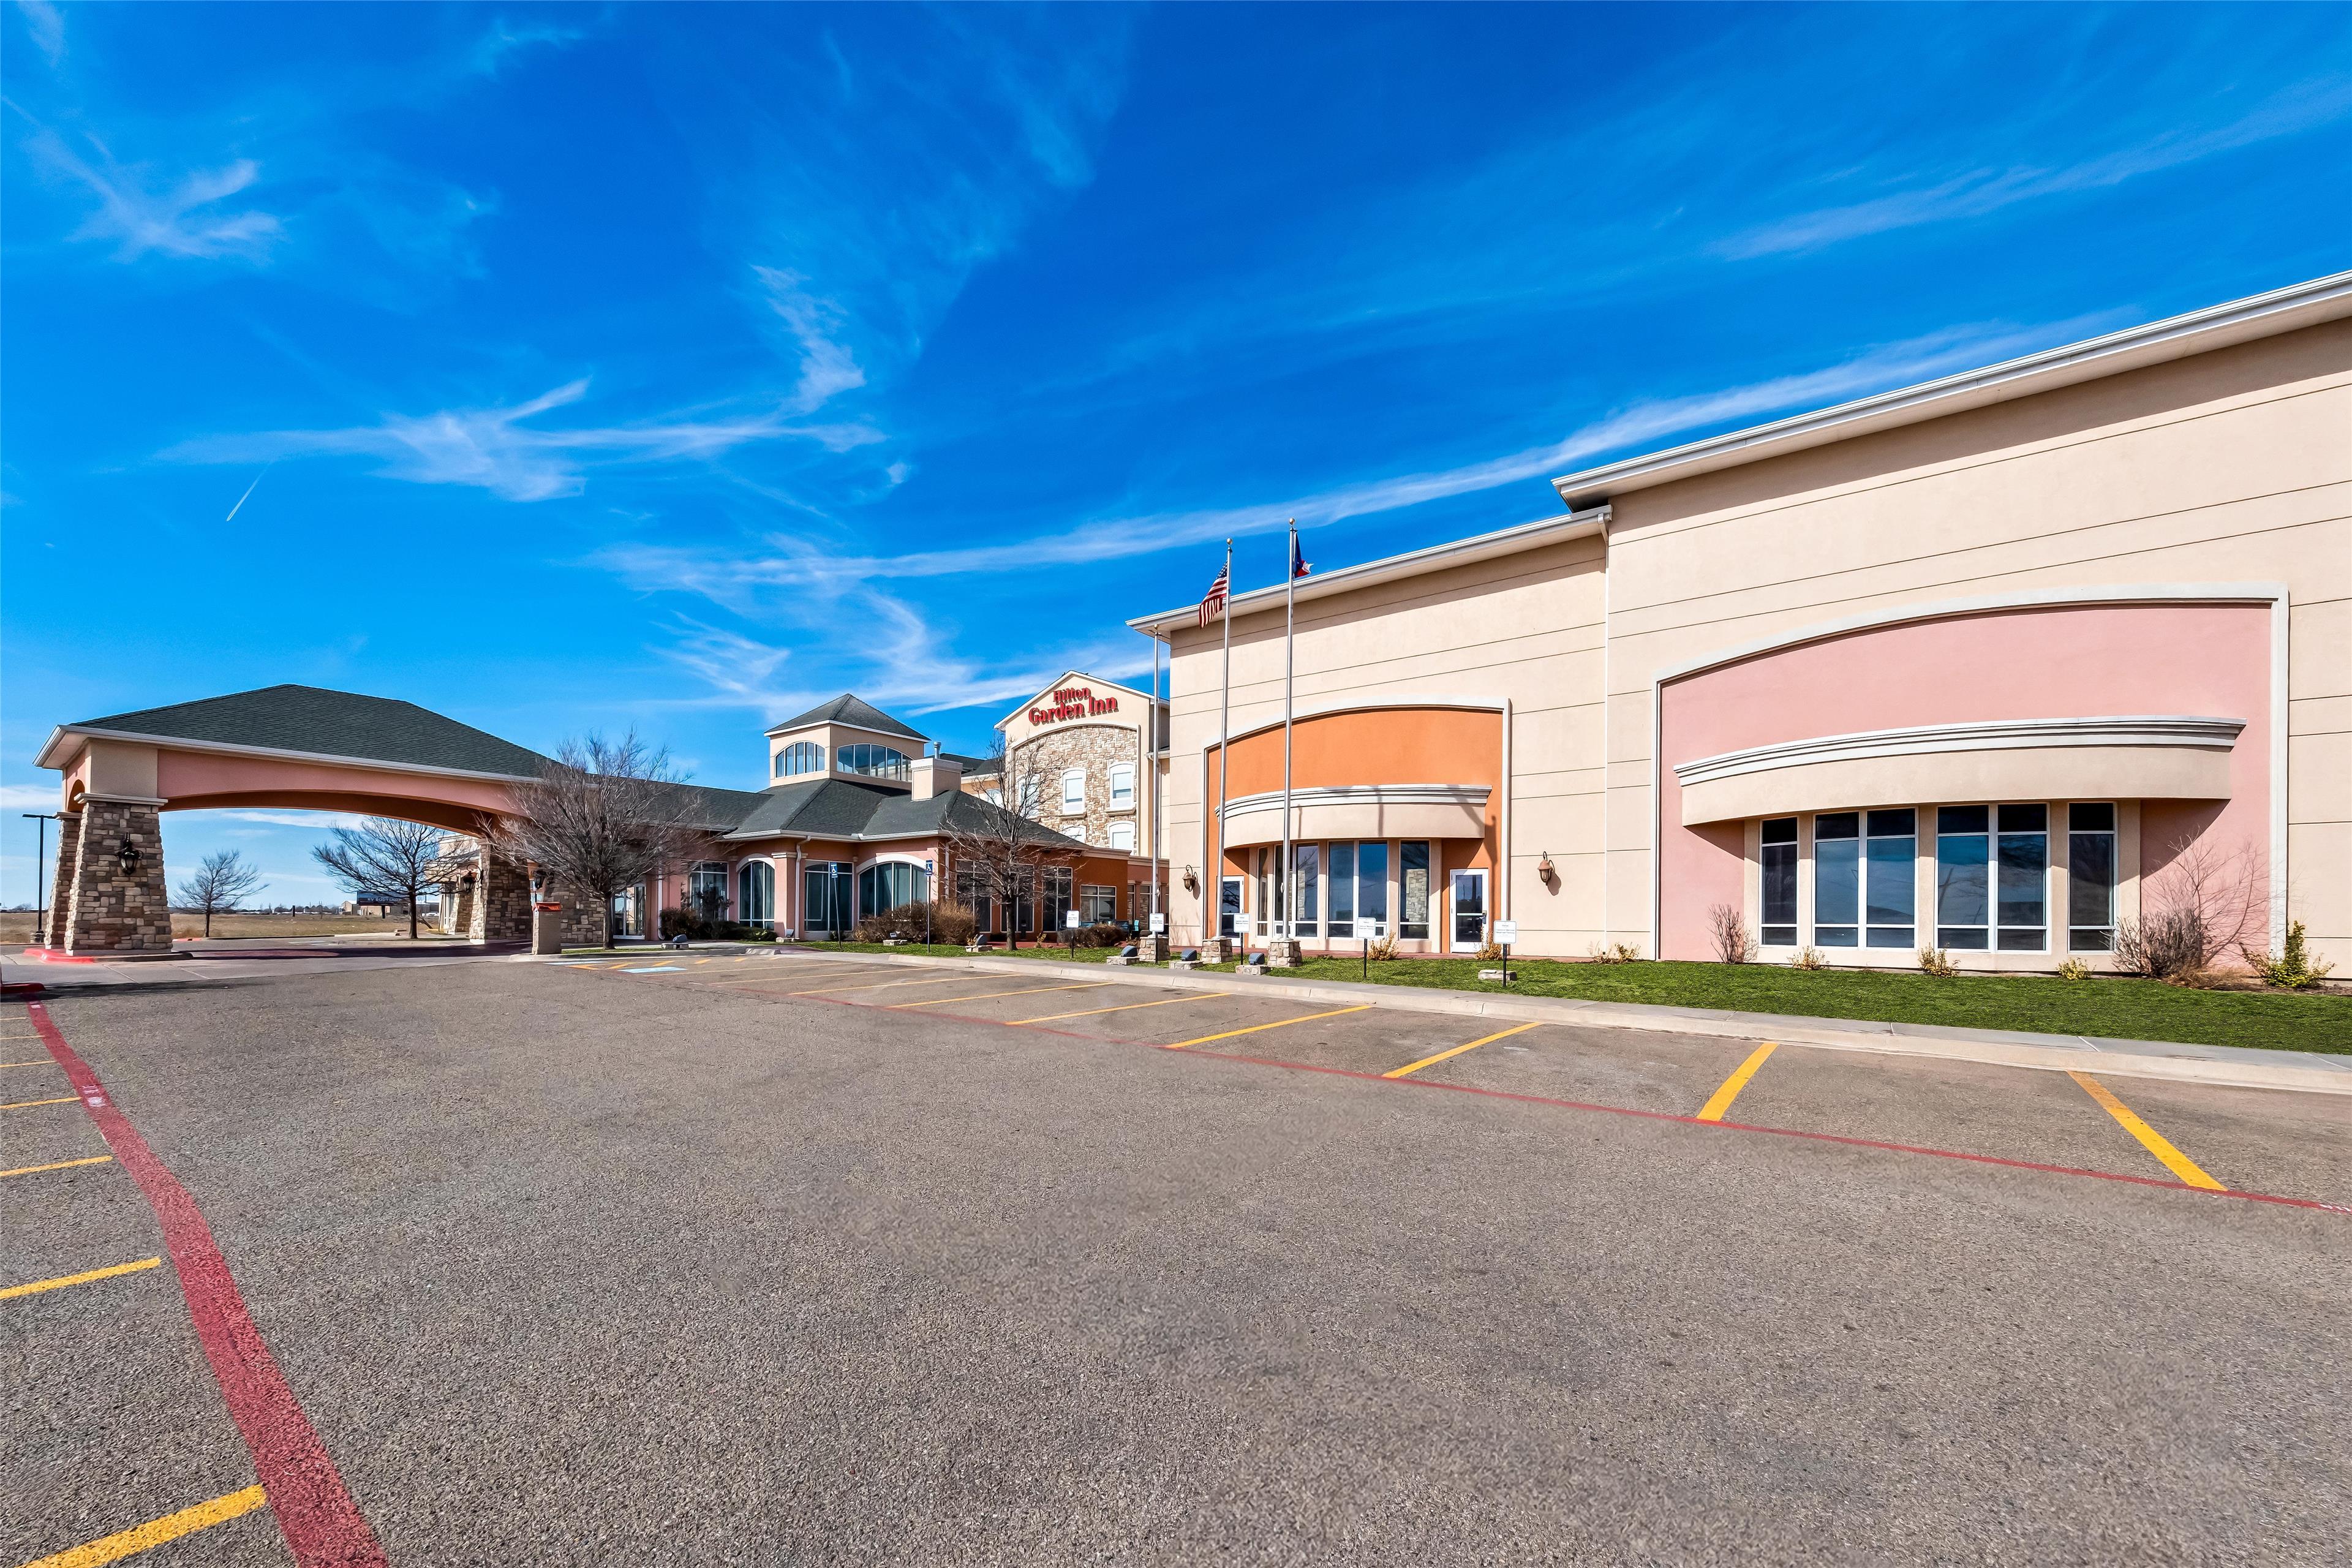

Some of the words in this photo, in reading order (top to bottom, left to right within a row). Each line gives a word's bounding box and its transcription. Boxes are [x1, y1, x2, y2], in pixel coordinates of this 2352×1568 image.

[1053, 687, 1090, 703] Hilton
[1028, 701, 1085, 723] Garden
[1088, 696, 1118, 714] Inn
